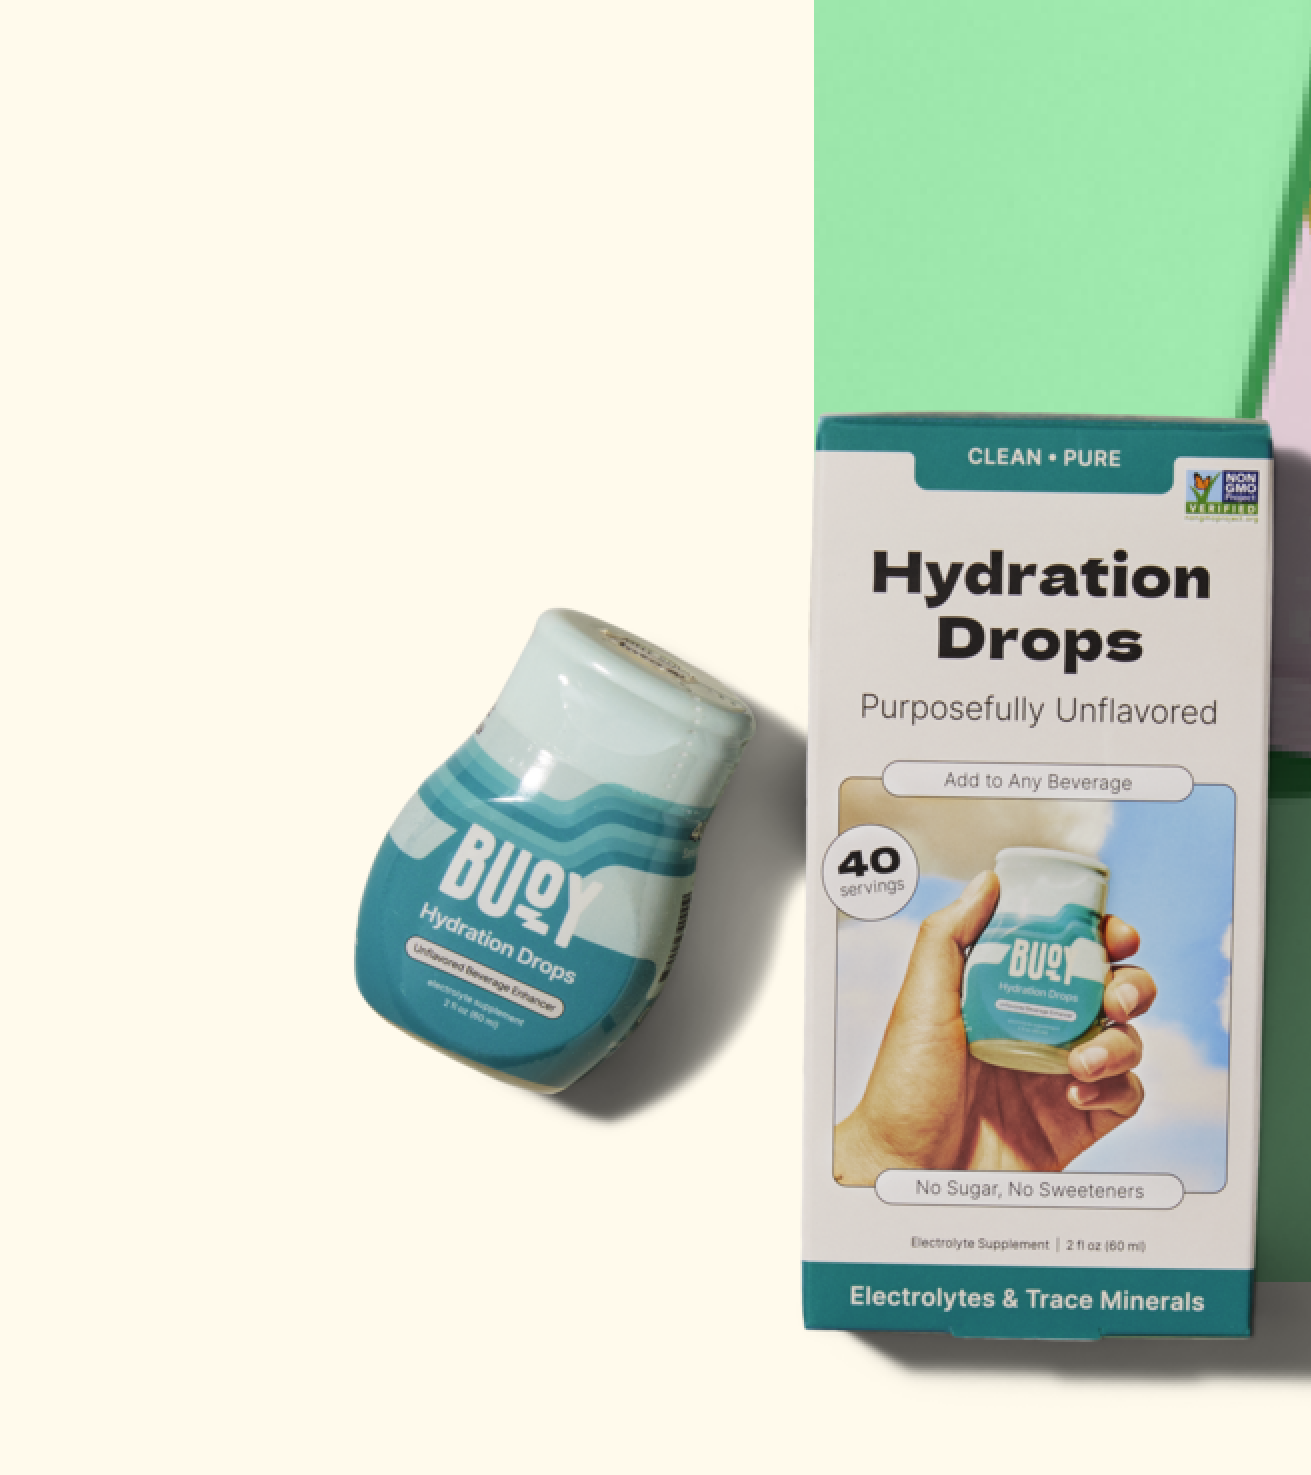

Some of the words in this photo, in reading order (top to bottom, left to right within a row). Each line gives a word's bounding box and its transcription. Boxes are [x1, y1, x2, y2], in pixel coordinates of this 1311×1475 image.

[967, 447, 1042, 467] CLEAN
[1062, 448, 1122, 468] PURE
[1225, 473, 1257, 483] NON
[1225, 483, 1257, 493] GMO
[1189, 503, 1256, 513] VERIFIED
[872, 548, 1211, 608] Hydration
[937, 615, 1143, 675] Drops
[861, 692, 1046, 728] Purposefully
[1056, 696, 1218, 726] Unflavored
[943, 772, 980, 789] Add
[985, 774, 1003, 789] to
[1007, 772, 1042, 793] Any
[1046, 773, 1133, 795] Beverage
[837, 845, 902, 877] 40
[437, 822, 604, 949] BUOY
[839, 876, 905, 899] servings
[420, 902, 514, 958] Hydration
[516, 946, 577, 984] Drops
[1008, 937, 1079, 986] BUOY
[413, 942, 466, 973] Unflavored
[465, 964, 511, 994] Beverage
[511, 985, 557, 1012] Enhancer
[916, 1178, 942, 1198] No
[946, 1179, 1003, 1204] Sugar,
[1007, 1180, 1034, 1199] No
[1038, 1180, 1146, 1202] Sweeteners
[910, 1235, 975, 1252] Electrolyte
[977, 1236, 1051, 1253] Supplement
[1065, 1238, 1074, 1251] 2
[1087, 1240, 1103, 1251] oz
[1105, 1237, 1126, 1254] (60
[849, 1285, 996, 1313] Electrolytes
[1001, 1287, 1019, 1309] &
[1025, 1288, 1094, 1310] Trace
[1100, 1289, 1205, 1313] Minerals
